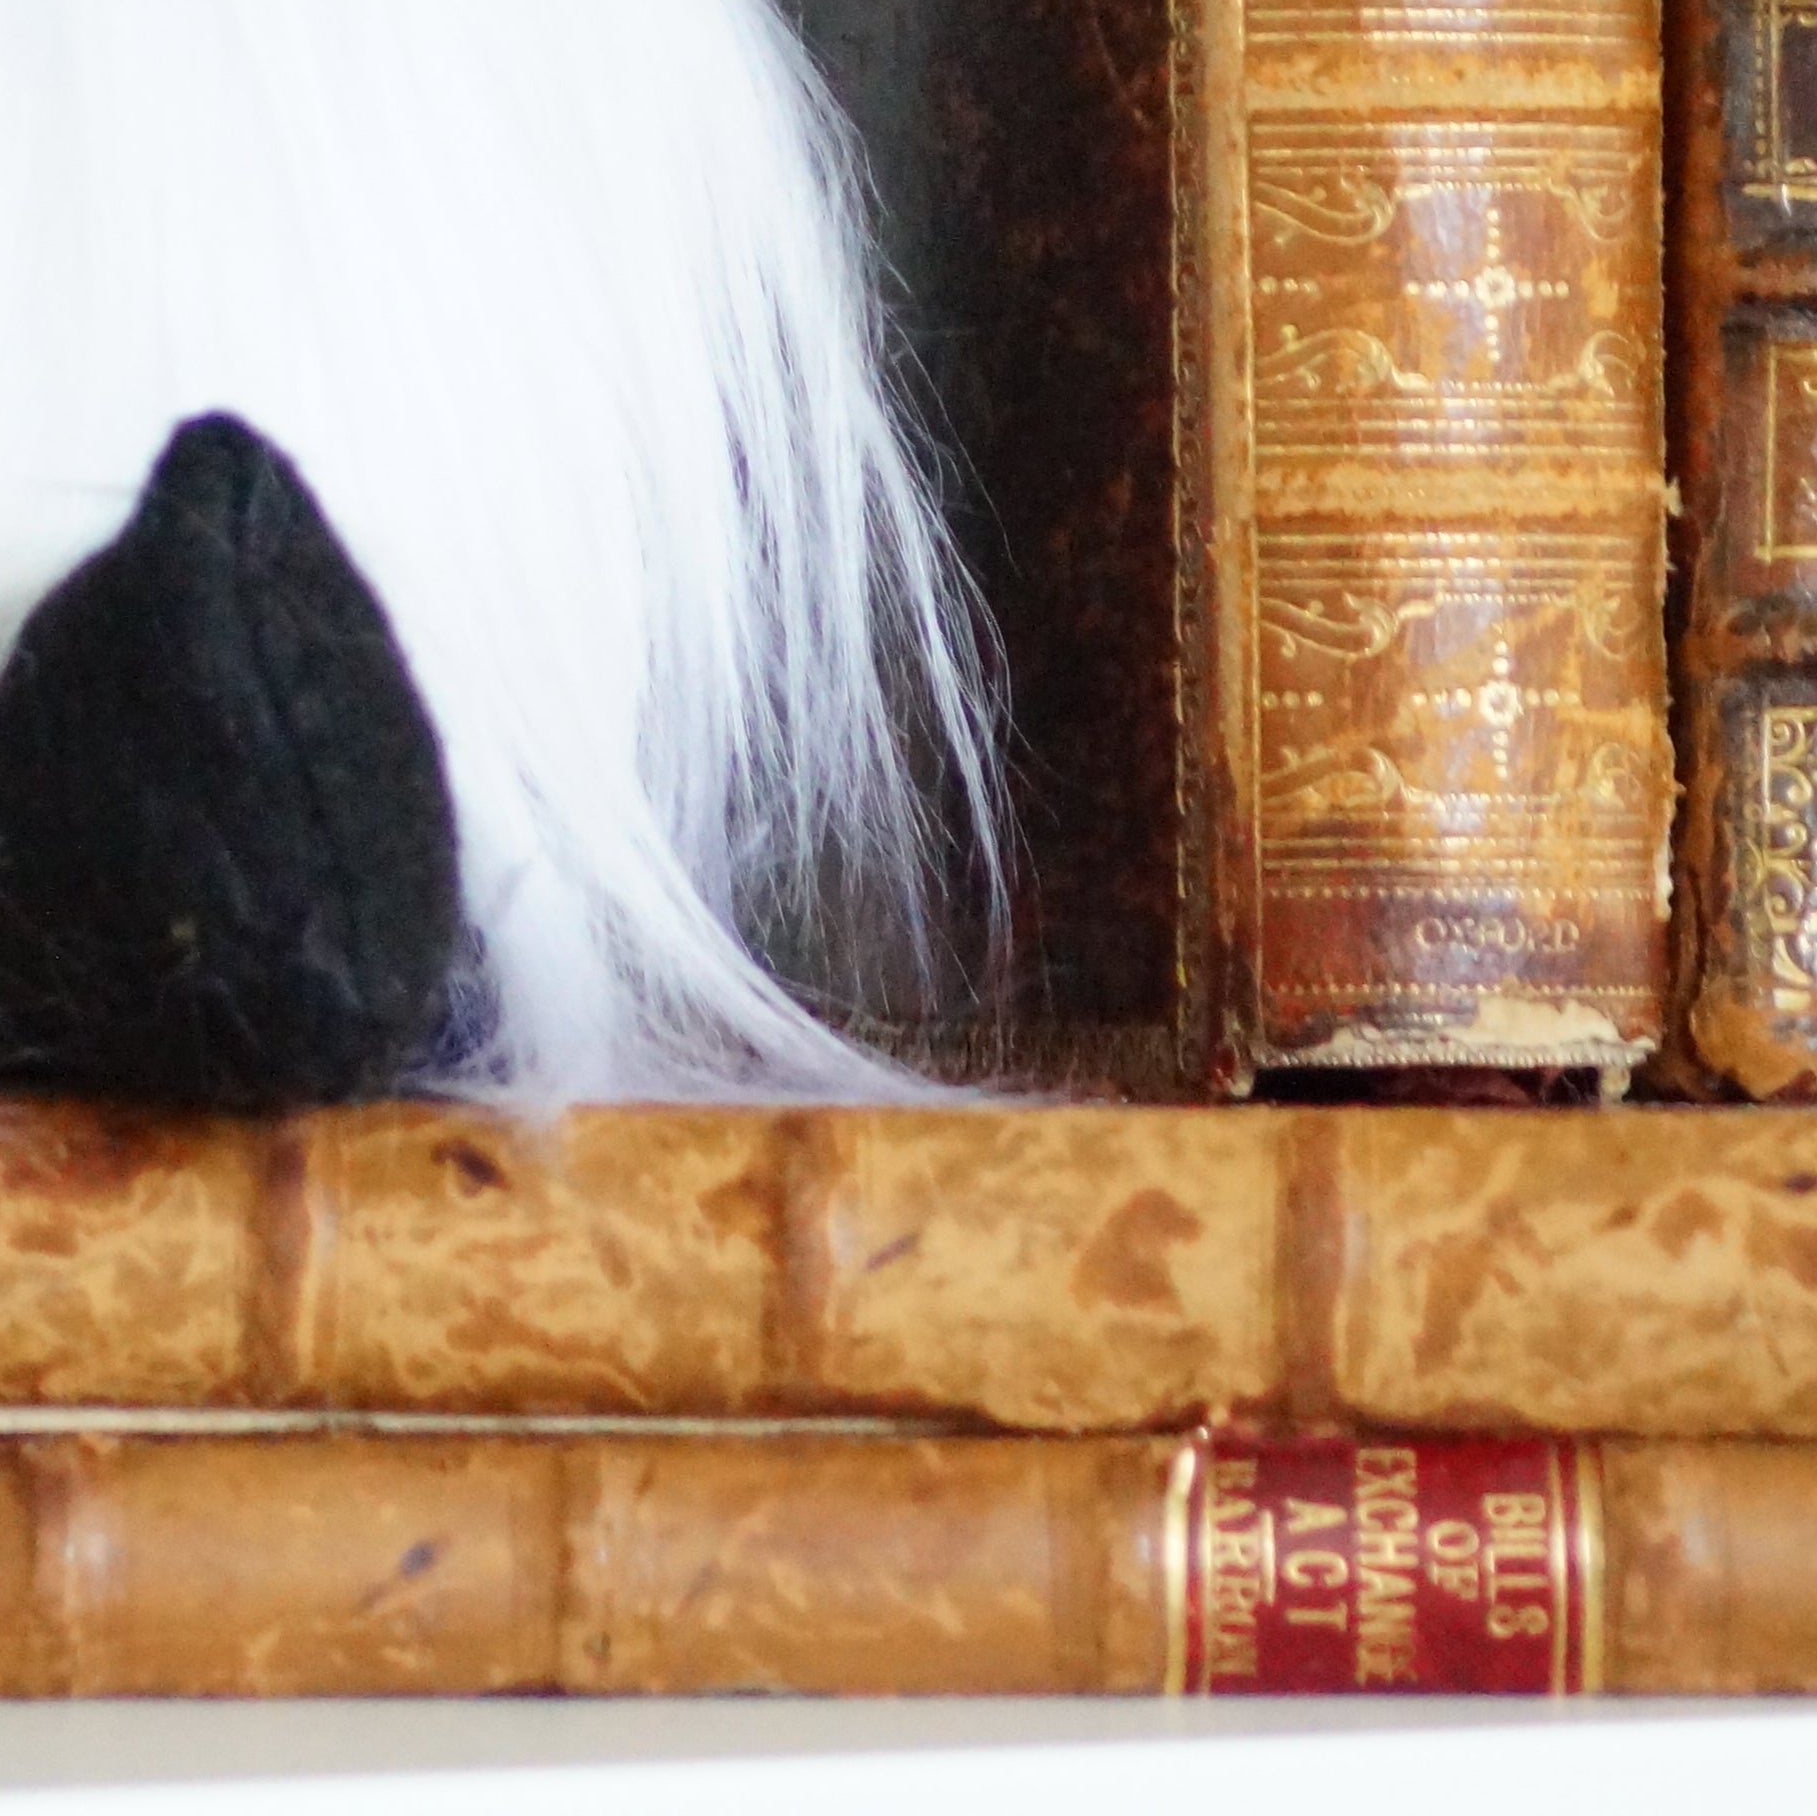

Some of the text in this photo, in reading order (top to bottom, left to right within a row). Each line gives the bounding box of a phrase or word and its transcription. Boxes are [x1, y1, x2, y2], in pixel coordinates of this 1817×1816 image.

[1282, 1496, 1349, 1632] ACT
[1425, 1519, 1481, 1601] OF
[1481, 1492, 1550, 1640] BILLS
